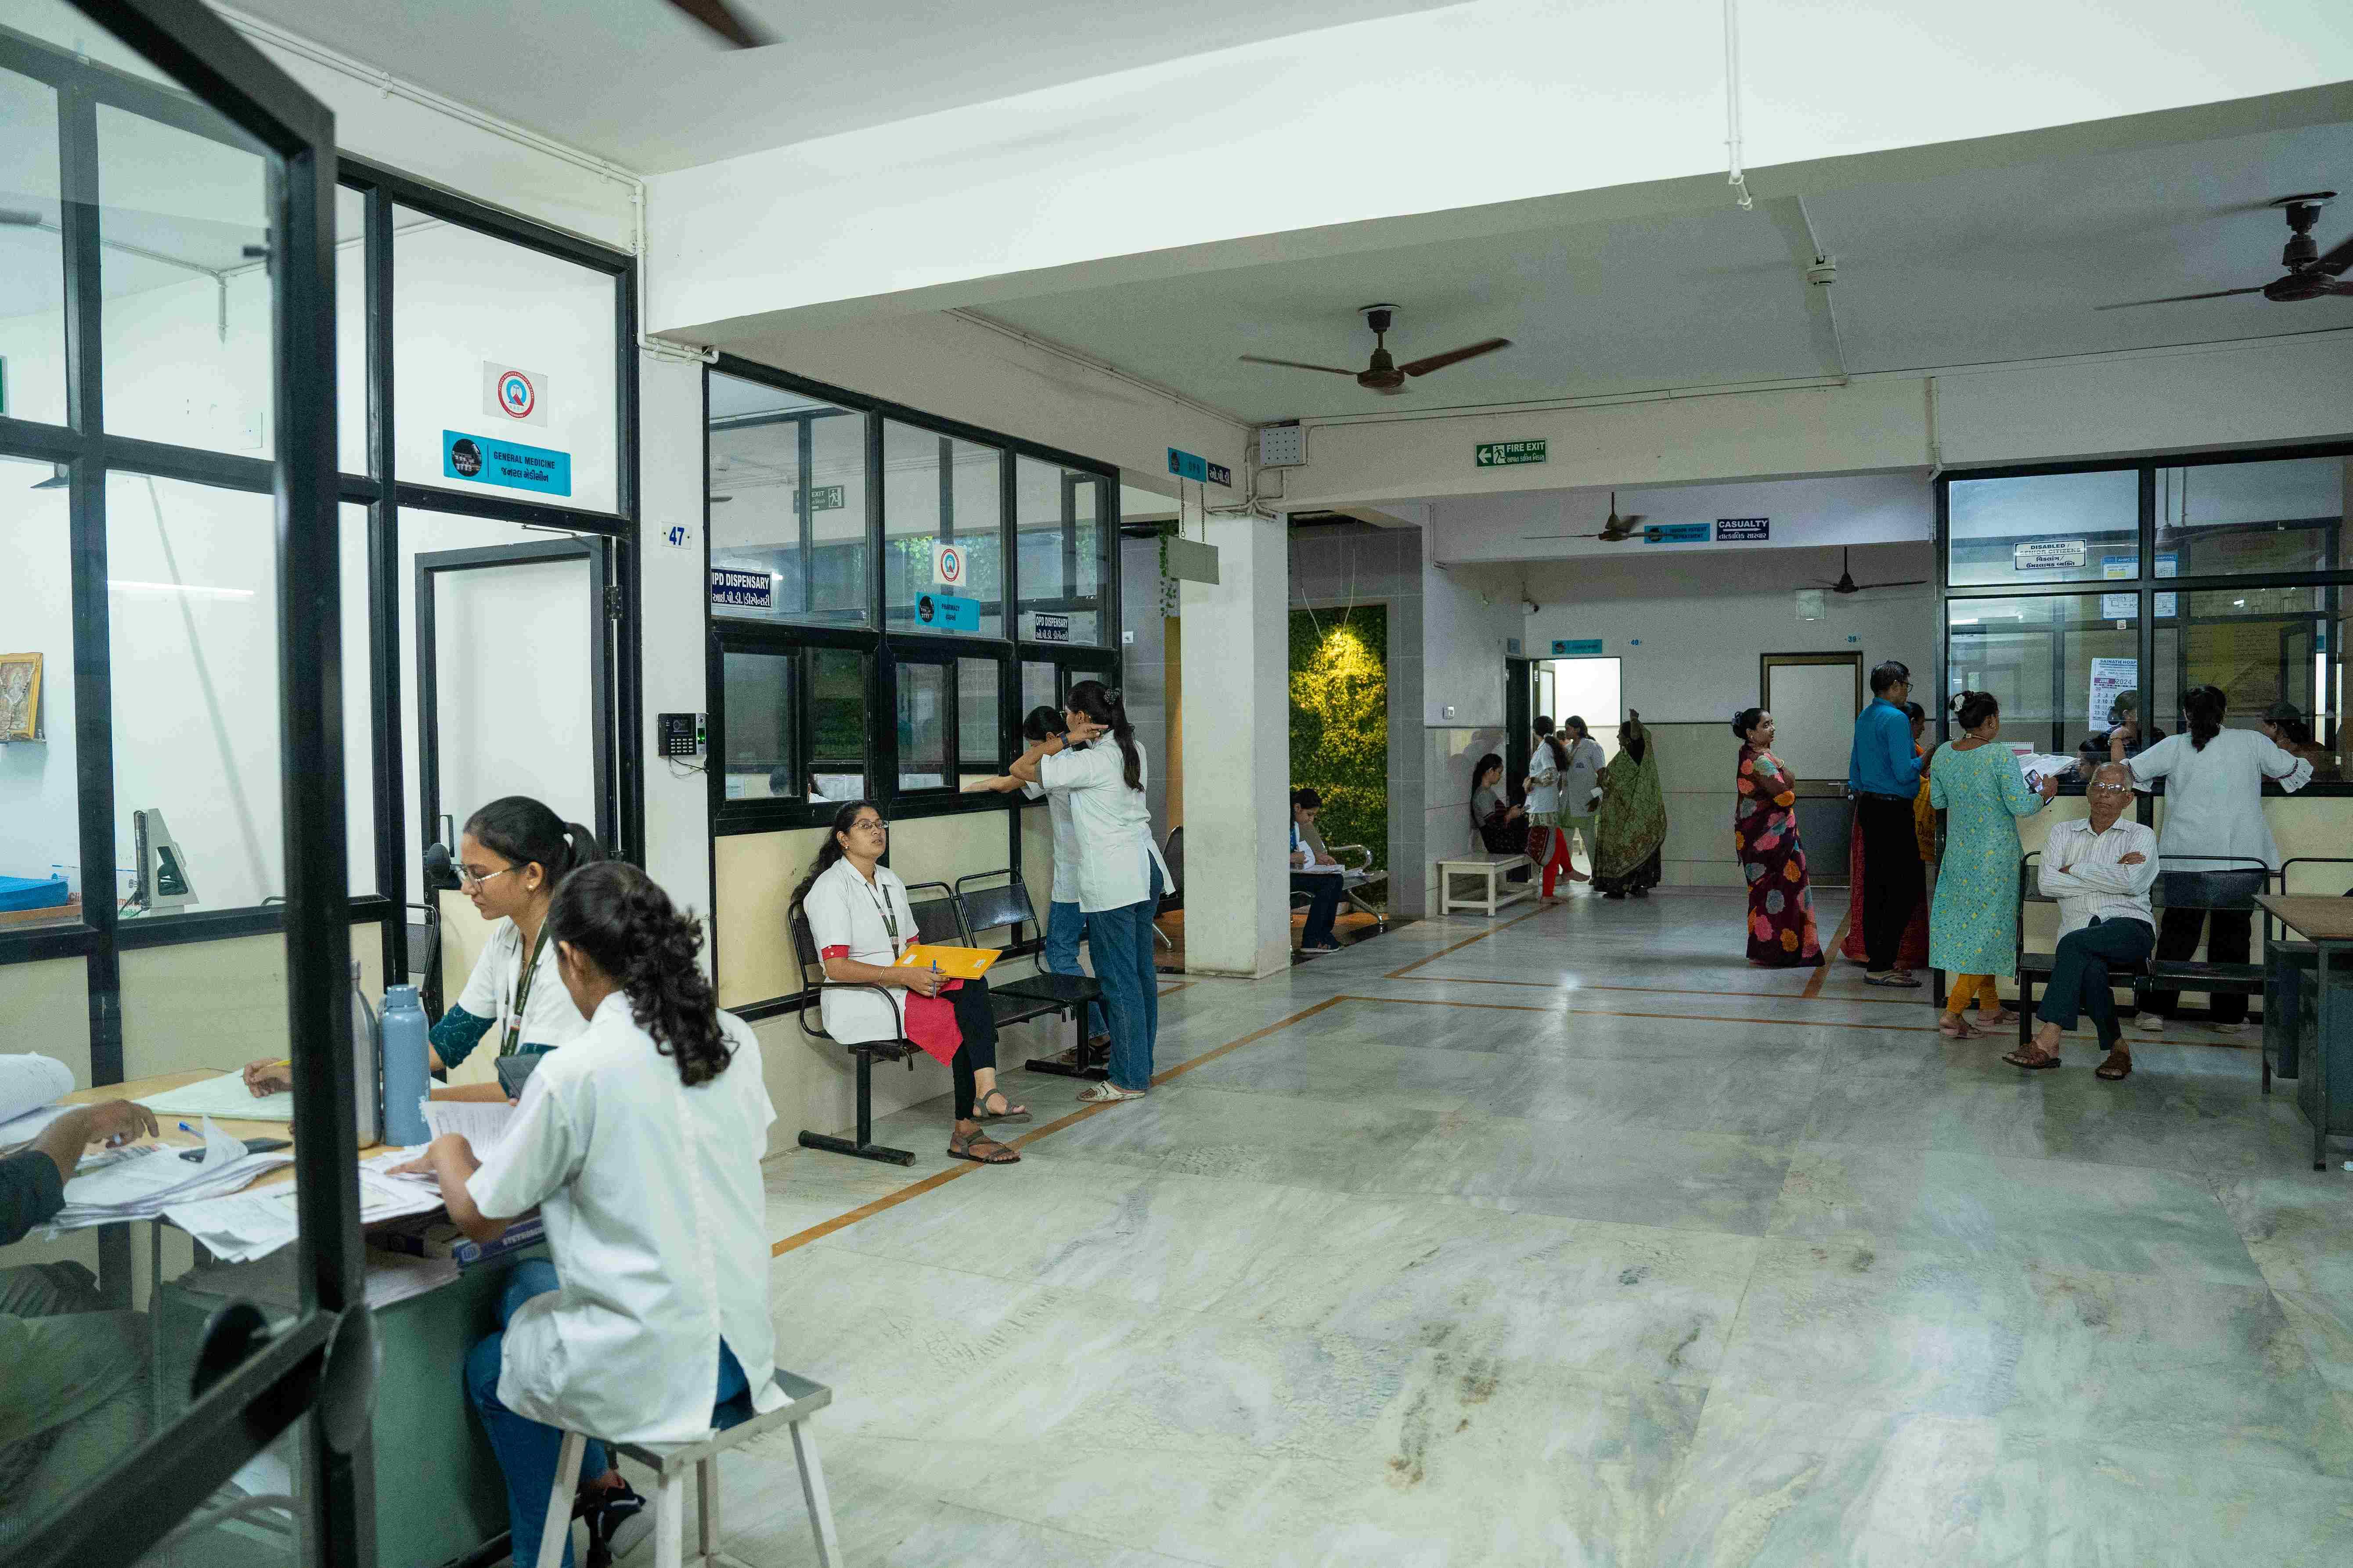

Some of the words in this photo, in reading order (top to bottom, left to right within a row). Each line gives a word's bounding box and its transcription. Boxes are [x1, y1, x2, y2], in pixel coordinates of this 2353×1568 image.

[1506, 444, 1524, 453] FIRE
[1527, 442, 1545, 451] EXIT
[494, 451, 522, 464] GENERAL
[525, 457, 555, 469] MEDICINE
[501, 467, 522, 478] જનરલ
[669, 527, 685, 546] 47
[712, 572, 724, 586] IPD
[726, 574, 769, 590] DISPENSARY
[1045, 617, 1068, 628] DISPENSARY
